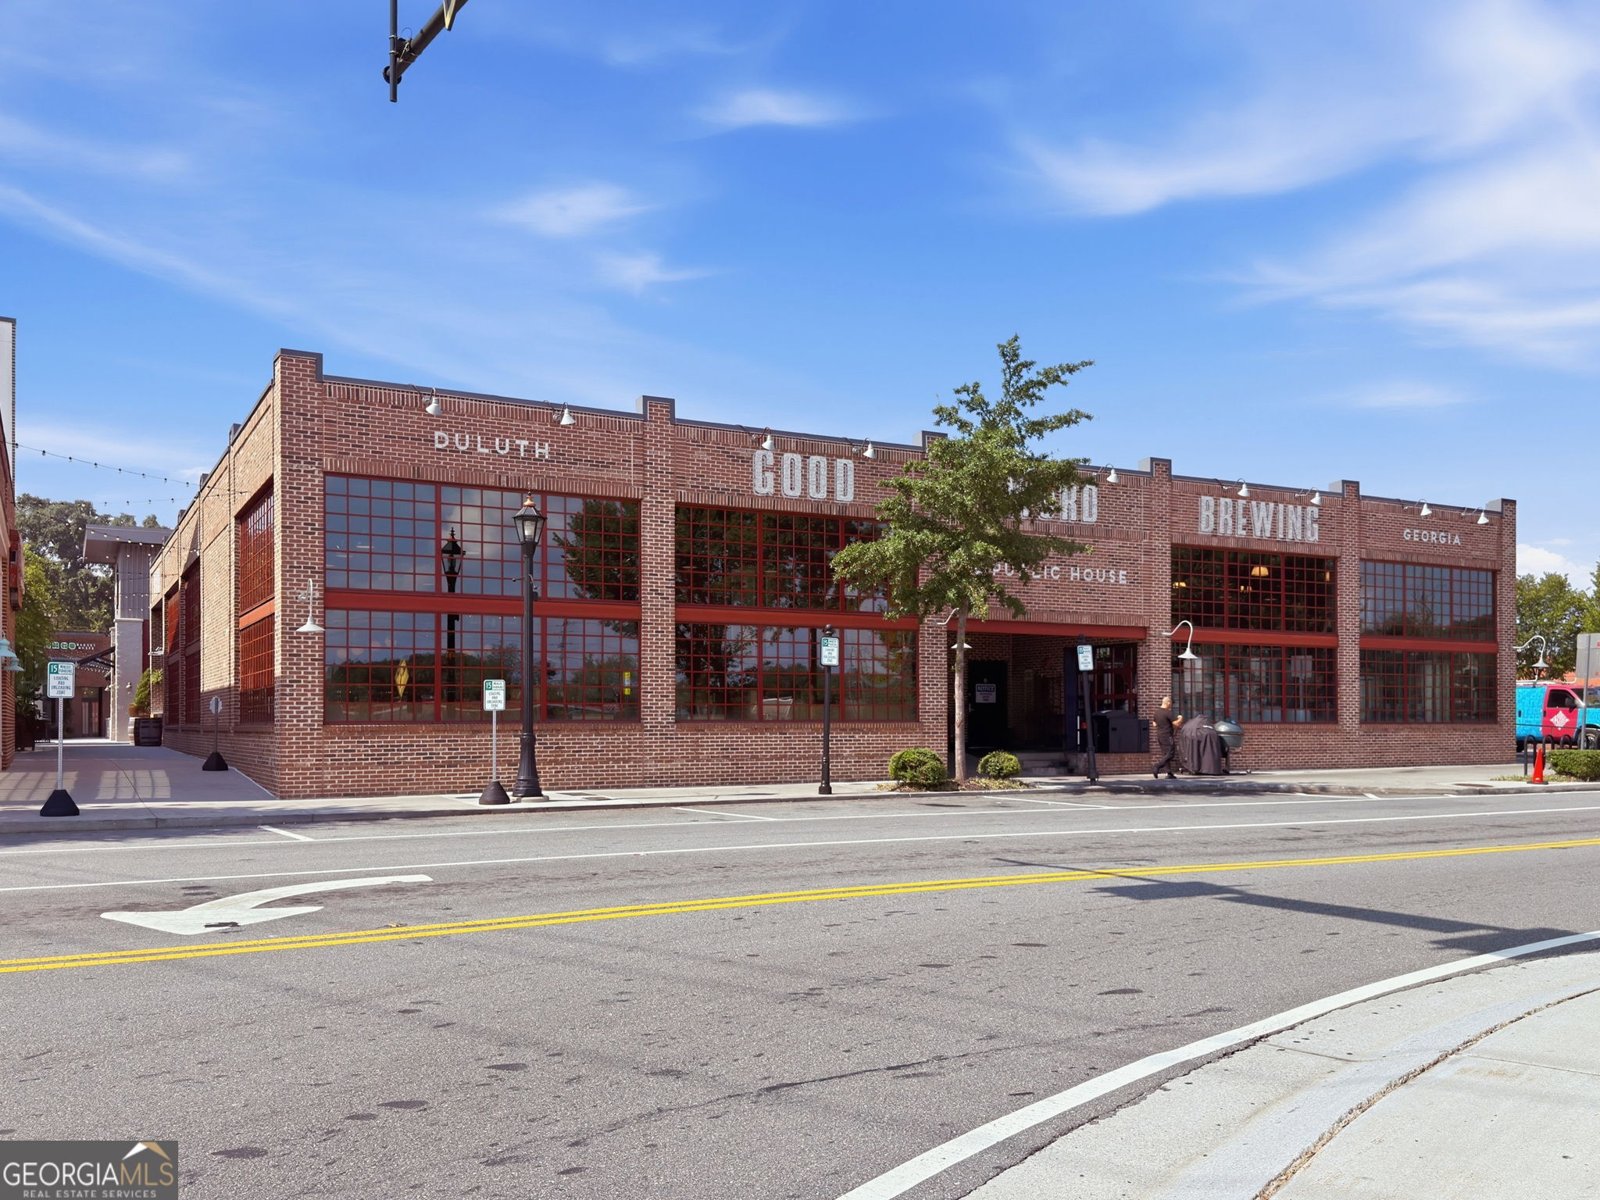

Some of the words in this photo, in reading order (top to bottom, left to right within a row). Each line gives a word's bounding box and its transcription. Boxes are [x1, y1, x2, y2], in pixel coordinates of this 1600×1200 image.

[433, 431, 549, 459] DULUTH
[752, 449, 854, 503] GOOD
[1007, 476, 1098, 524] RD
[1198, 495, 1319, 543] BREWING
[1403, 528, 1461, 545] GEORGIA
[1070, 566, 1127, 584] HOUSE
[50, 664, 58, 673] 15
